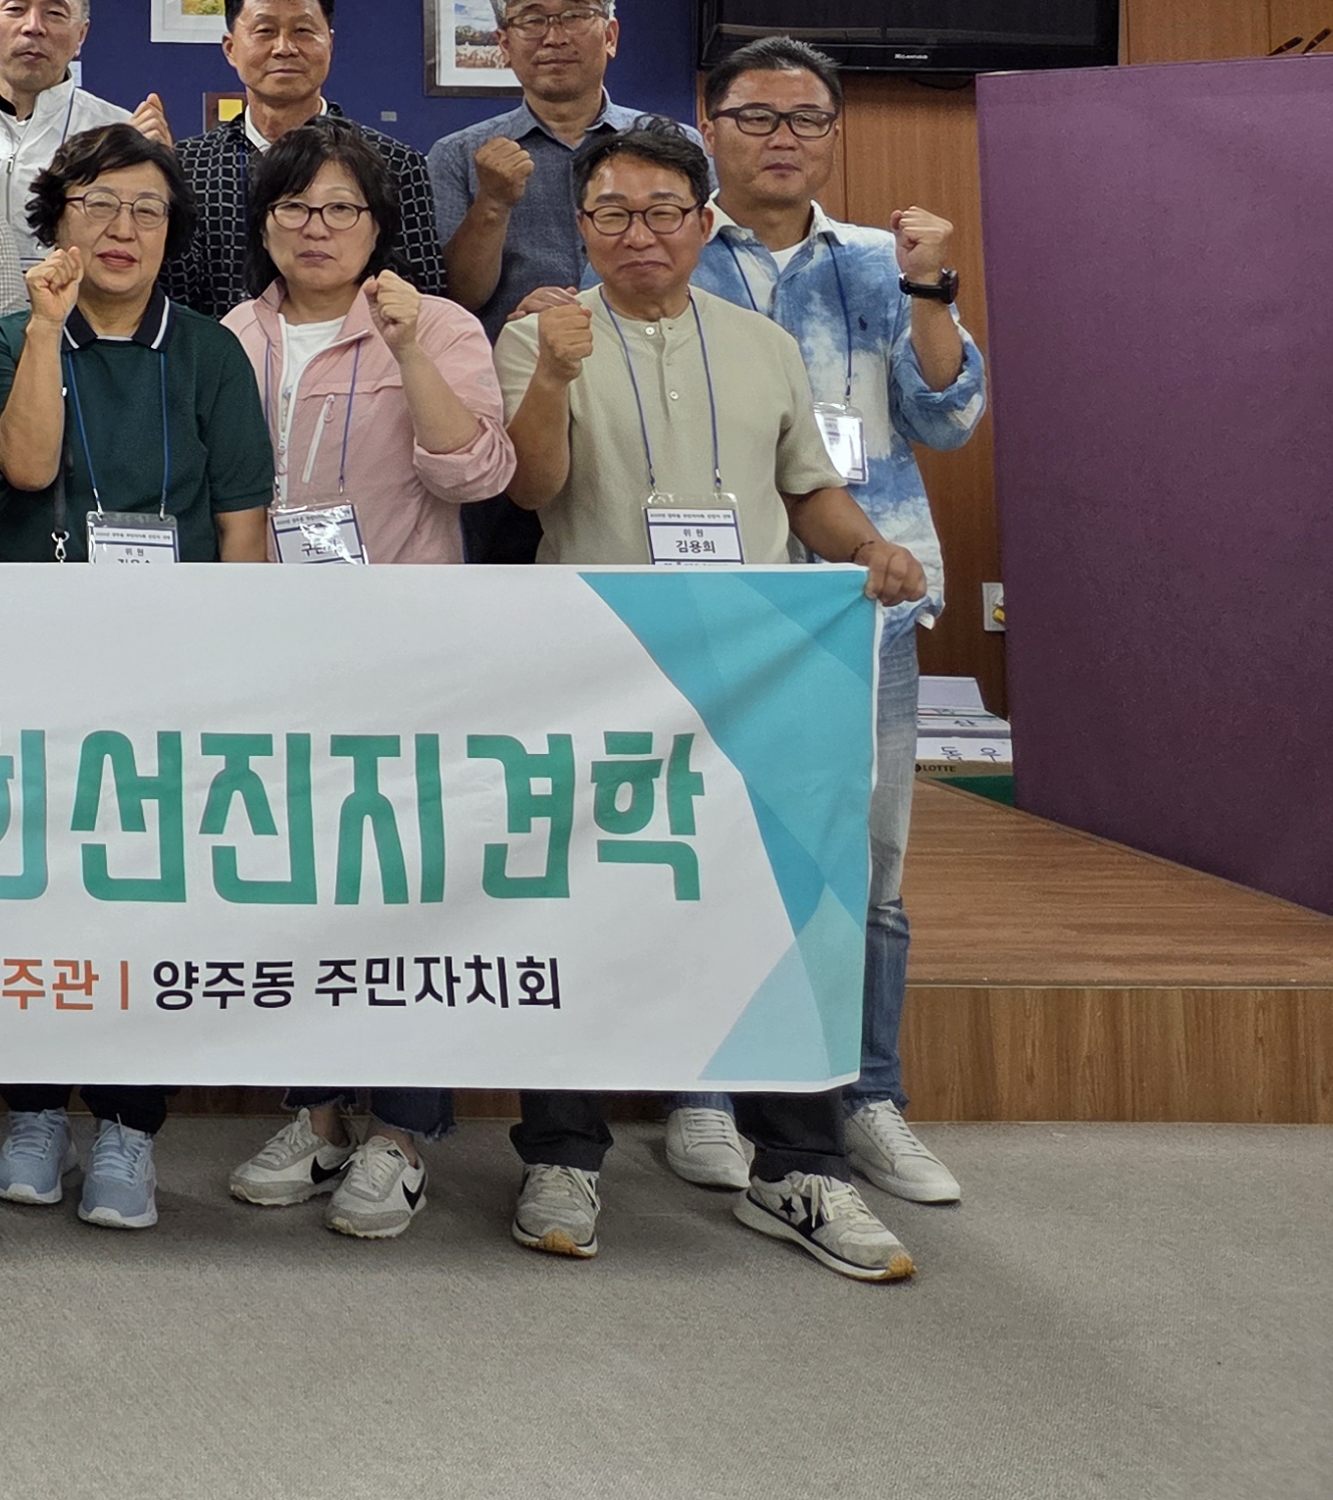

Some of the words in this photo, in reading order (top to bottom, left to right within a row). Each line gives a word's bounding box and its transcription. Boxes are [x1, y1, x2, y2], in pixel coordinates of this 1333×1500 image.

[923, 765, 956, 773] LOTTE
[2, 958, 100, 1011] 주관
[153, 960, 295, 1011] 양주동
[314, 955, 562, 1010] 주민자치회
